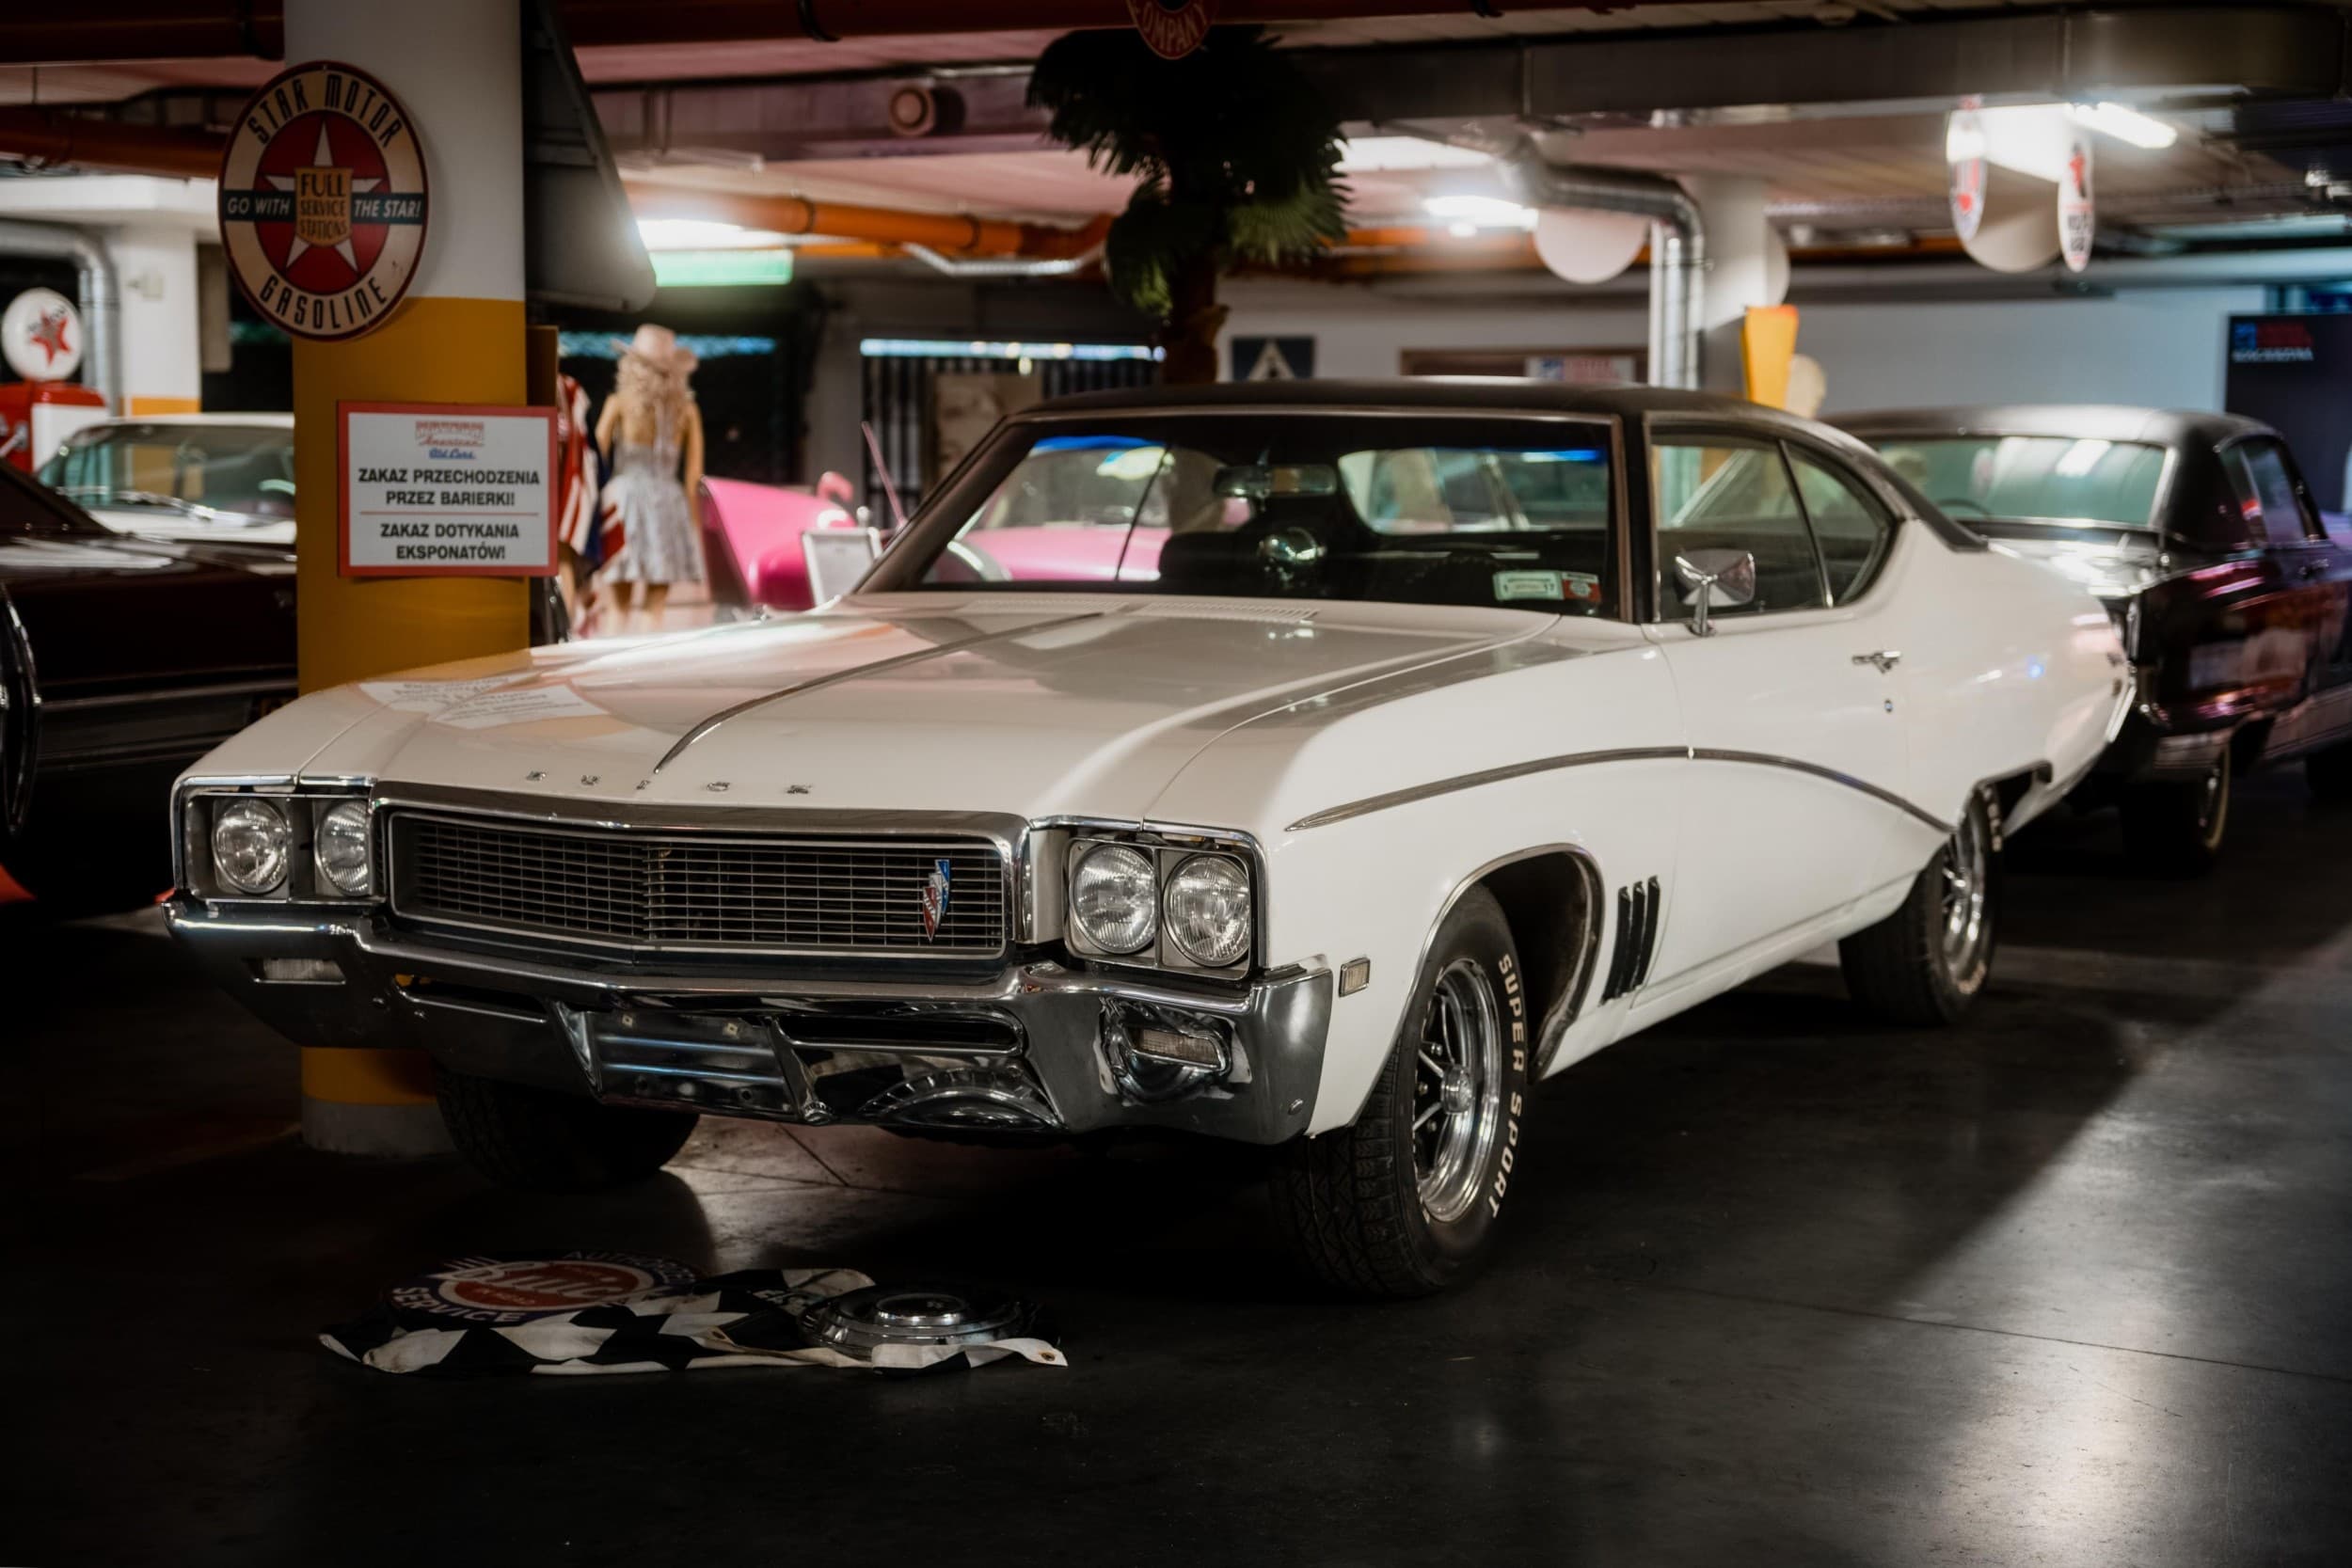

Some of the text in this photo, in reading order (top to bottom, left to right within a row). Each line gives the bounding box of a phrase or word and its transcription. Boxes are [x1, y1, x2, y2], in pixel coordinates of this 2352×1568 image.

[247, 73, 403, 148] STAR MOTOR
[300, 172, 345, 198] FULL
[227, 198, 292, 215] GO WITH
[354, 199, 421, 218] THE STAR!
[259, 274, 388, 329] GASOLINE
[358, 467, 540, 485] ZAKAZ PRZECHODZENIA
[386, 491, 436, 505] PRZEZ
[380, 523, 519, 539] ZAKAZ DOTYKANIA
[396, 542, 506, 560] EKSPONATÓW!
[1488, 953, 1525, 1219] SUPER SPORT
[391, 1286, 527, 1323] SERVICE
